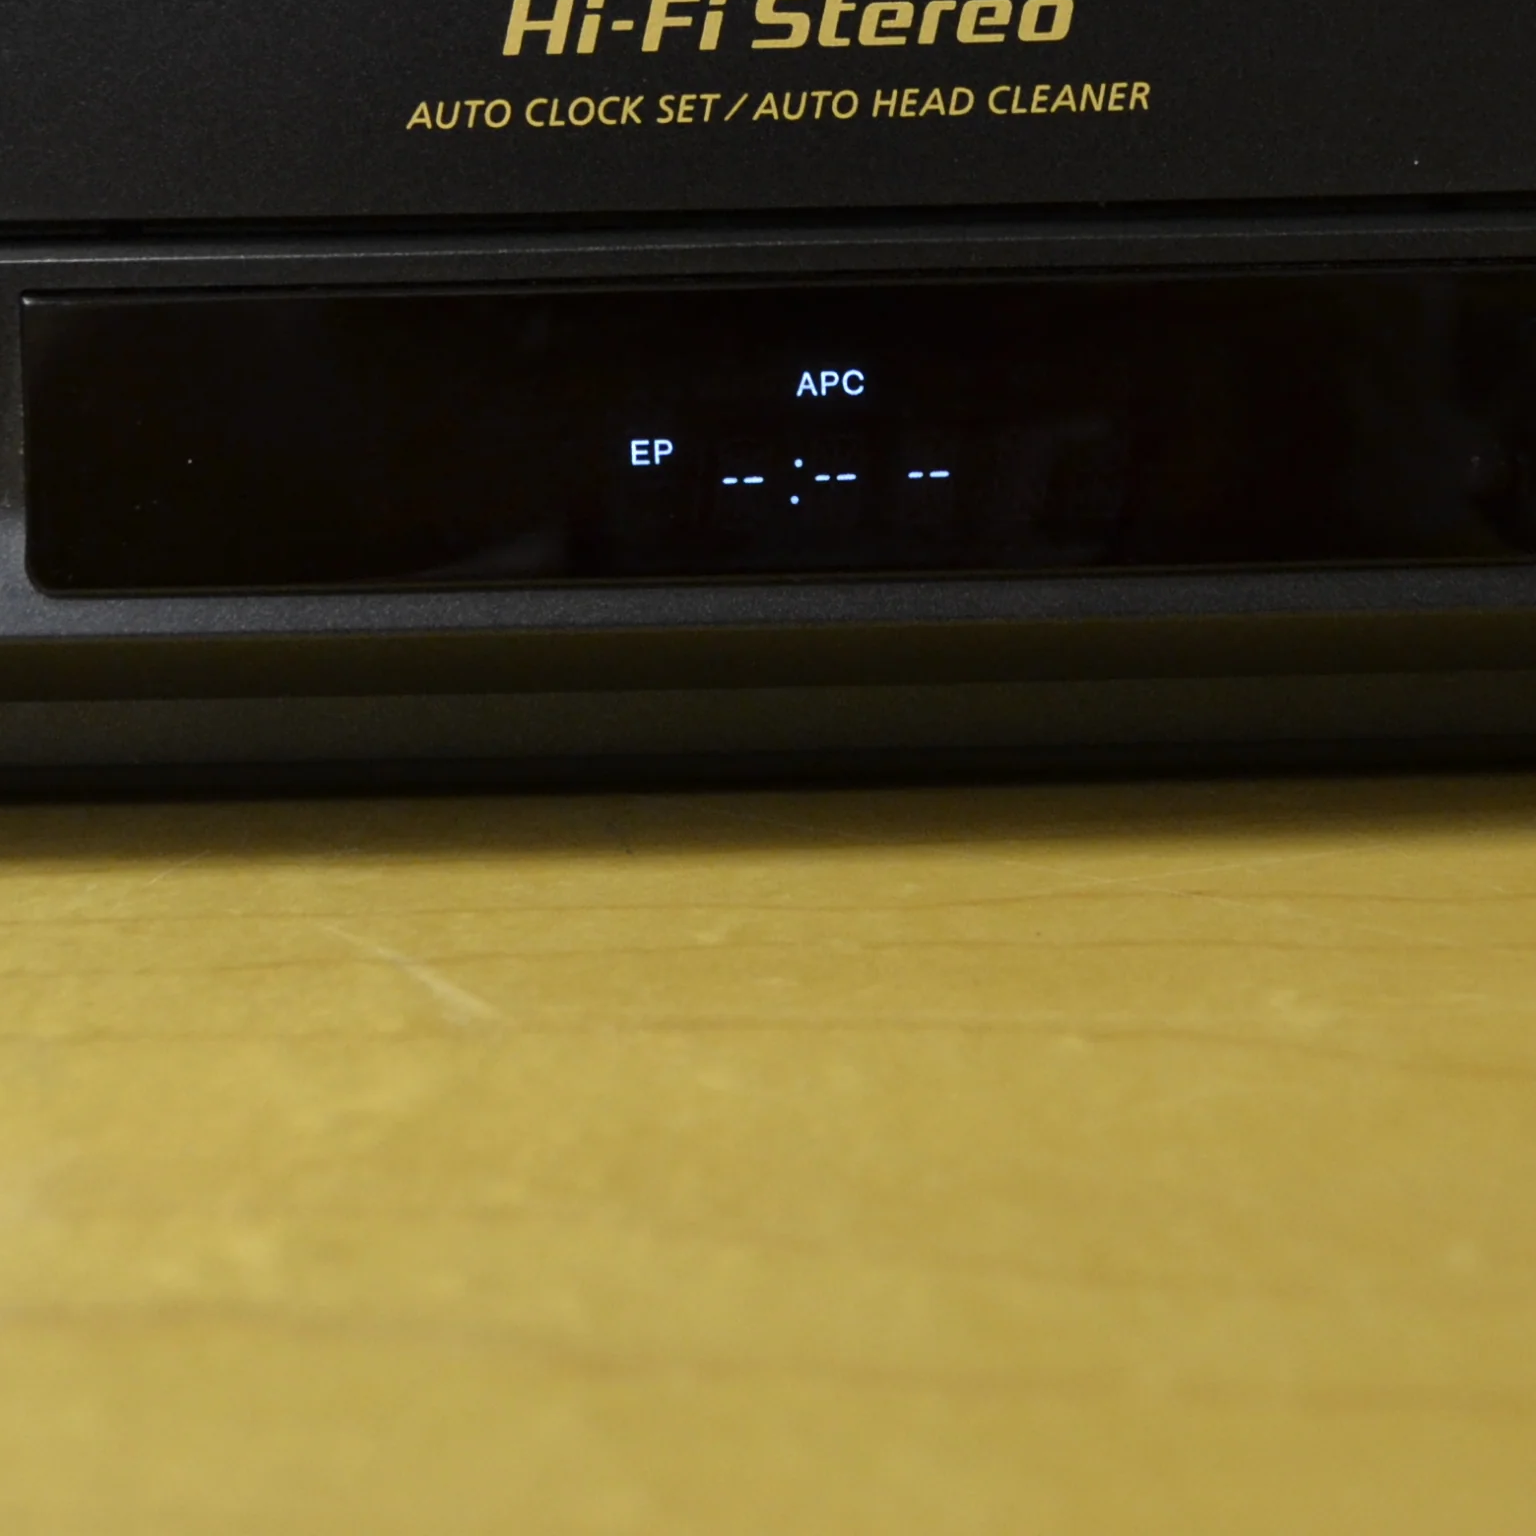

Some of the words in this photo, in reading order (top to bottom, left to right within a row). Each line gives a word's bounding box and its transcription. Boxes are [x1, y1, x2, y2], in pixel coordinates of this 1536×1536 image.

[406, 99, 512, 129] AUTO
[524, 95, 645, 127] CLOCK
[656, 95, 721, 123] SET
[752, 89, 859, 122] AUTO
[872, 87, 975, 118] HEAD
[987, 81, 1151, 114] CLEANER
[796, 369, 865, 397] APC
[630, 438, 674, 466] EP
